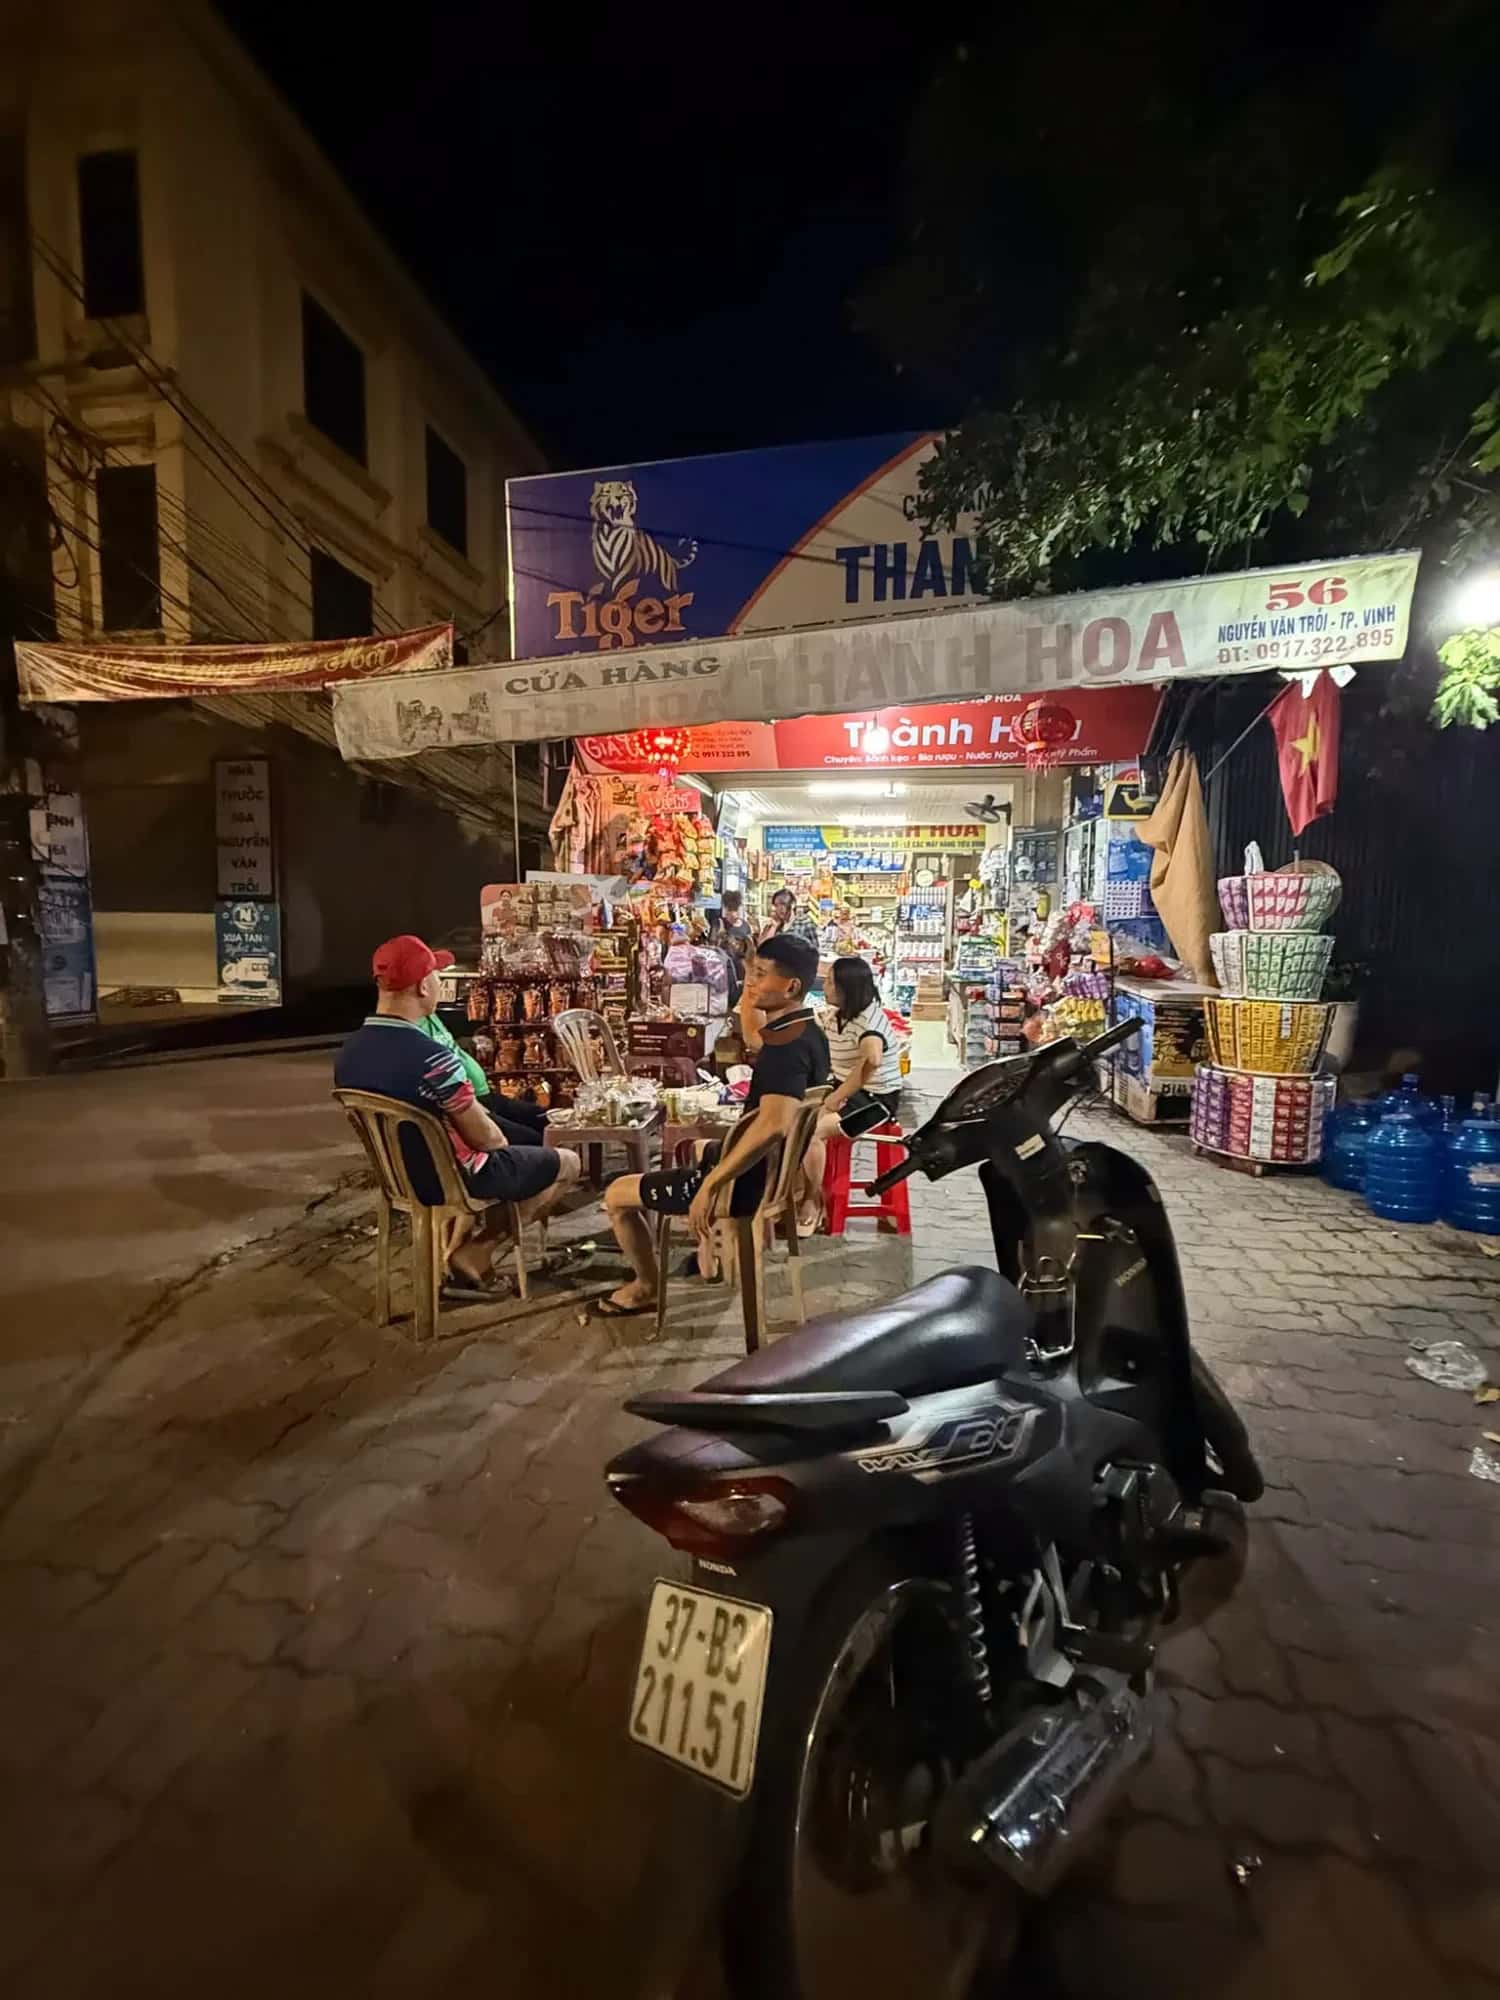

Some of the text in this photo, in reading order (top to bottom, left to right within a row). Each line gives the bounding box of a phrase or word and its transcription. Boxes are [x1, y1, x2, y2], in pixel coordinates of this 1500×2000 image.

[546, 578, 694, 649] Tiger
[1265, 577, 1348, 611] 56
[1364, 604, 1396, 627] VINH
[1025, 610, 1188, 683] HOA
[1256, 627, 1395, 660] 0917.322.895
[505, 656, 722, 695] CỬA HÀNG
[657, 1593, 748, 1687] 37-B3
[632, 1667, 747, 1782] 211.51
